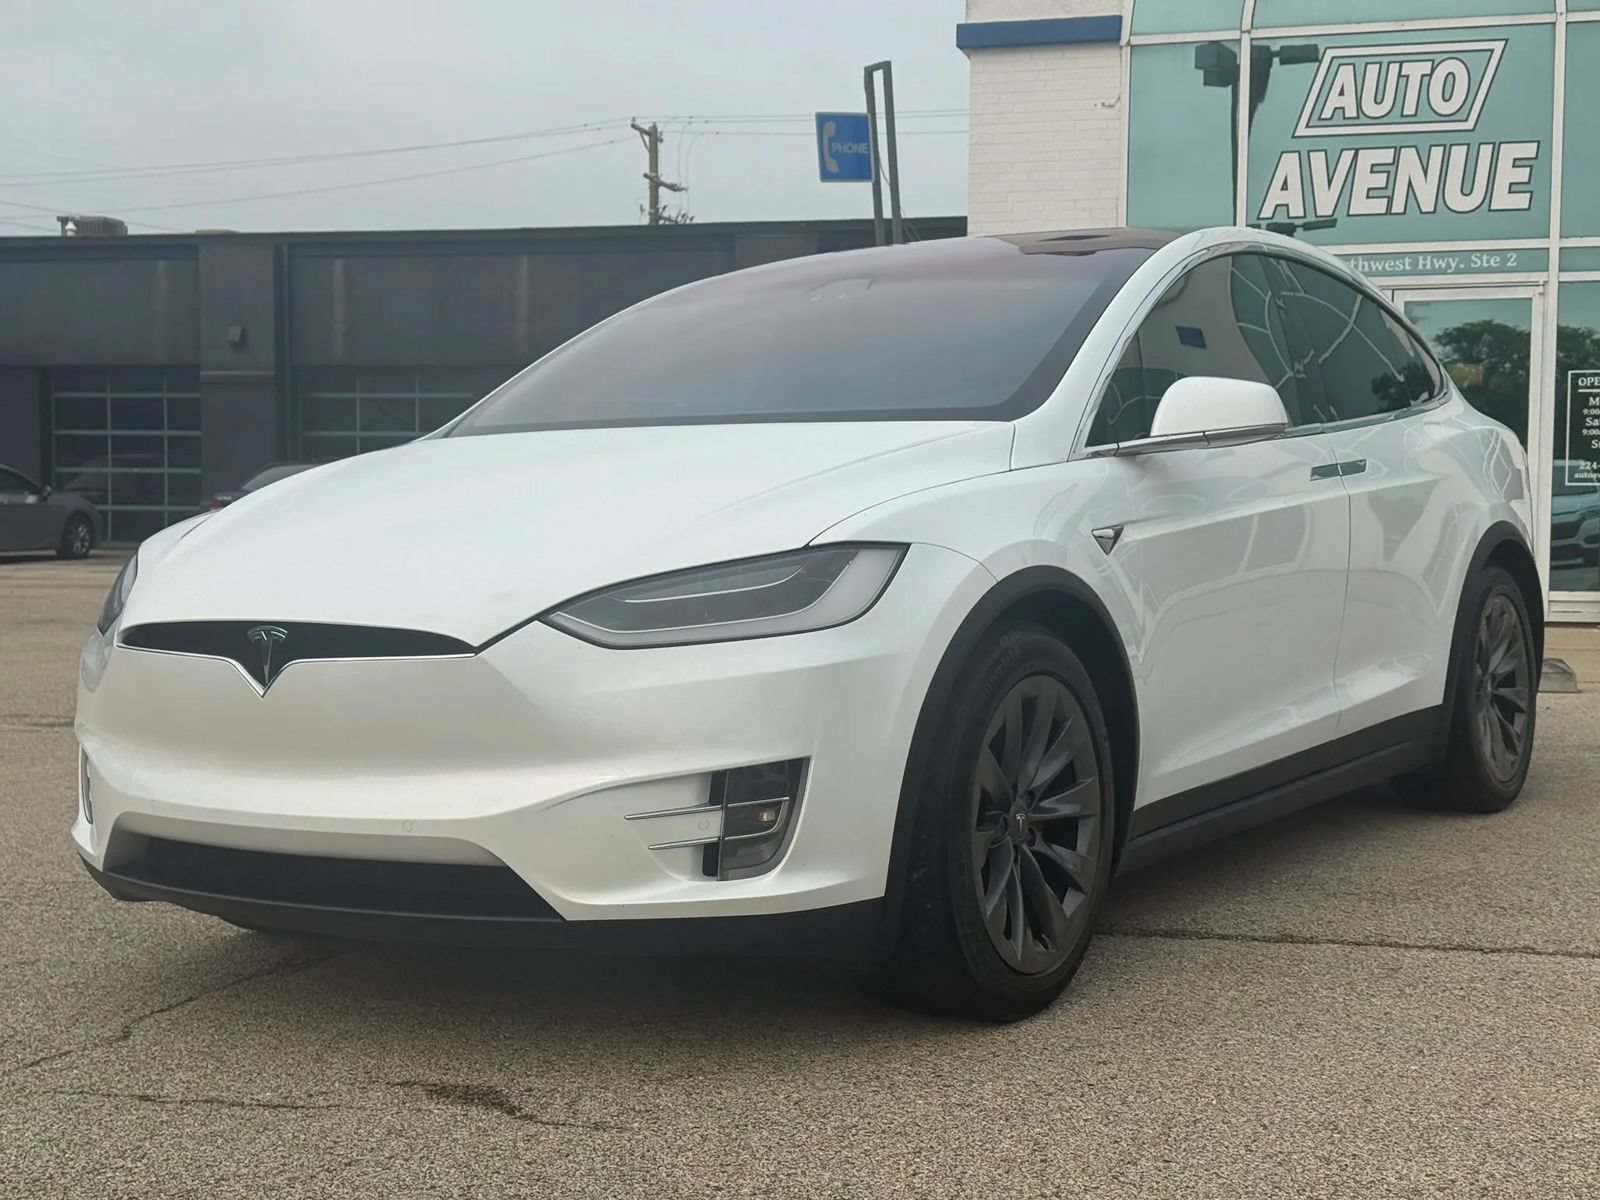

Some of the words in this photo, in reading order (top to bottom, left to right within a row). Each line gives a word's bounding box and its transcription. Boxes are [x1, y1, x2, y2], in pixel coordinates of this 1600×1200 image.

[1318, 57, 1470, 120] AUTO
[831, 142, 869, 154] PHONE
[1257, 141, 1540, 220] AVENUE
[1417, 255, 1464, 273] Hwy.
[1470, 252, 1500, 268] Ste
[1506, 252, 1517, 267] 2
[1585, 417, 1600, 426] Sa
[1582, 428, 1600, 436] 9:00
